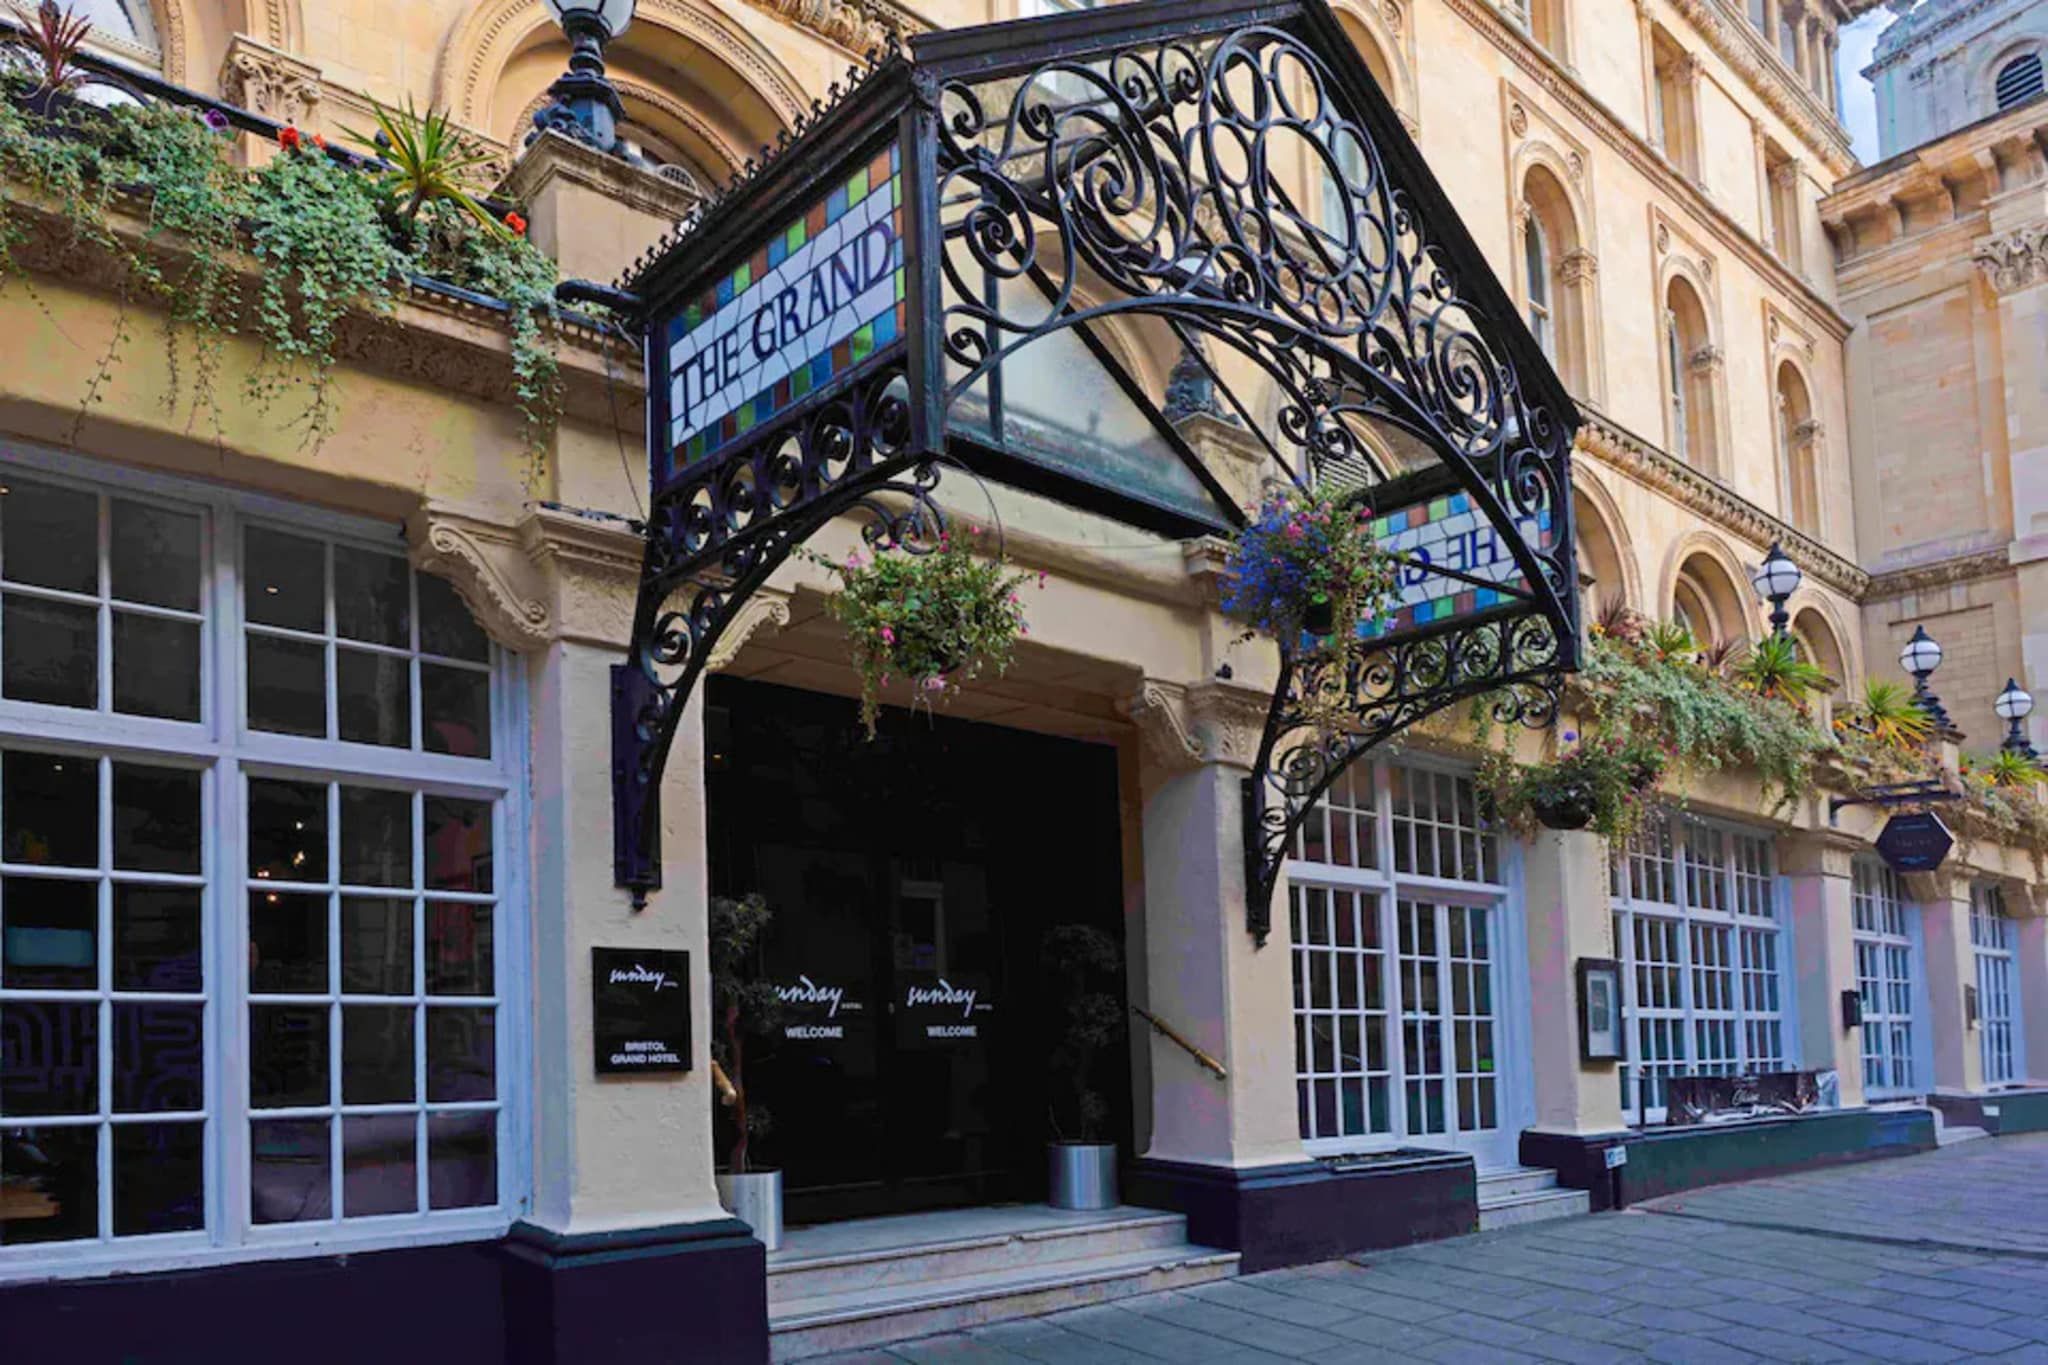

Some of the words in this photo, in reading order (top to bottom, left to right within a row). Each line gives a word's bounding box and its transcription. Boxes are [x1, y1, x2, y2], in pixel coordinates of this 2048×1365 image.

[670, 327, 741, 431] THE
[752, 221, 895, 360] GRAND
[609, 964, 665, 992] sunday
[774, 974, 843, 1018] unday
[906, 977, 976, 1018] sunday
[785, 1026, 844, 1039] WELCOME
[926, 1025, 977, 1038] WELCOME
[624, 1041, 667, 1052] BRISTOL
[610, 1053, 647, 1065] GRAND
[648, 1053, 681, 1064] HOTEL
